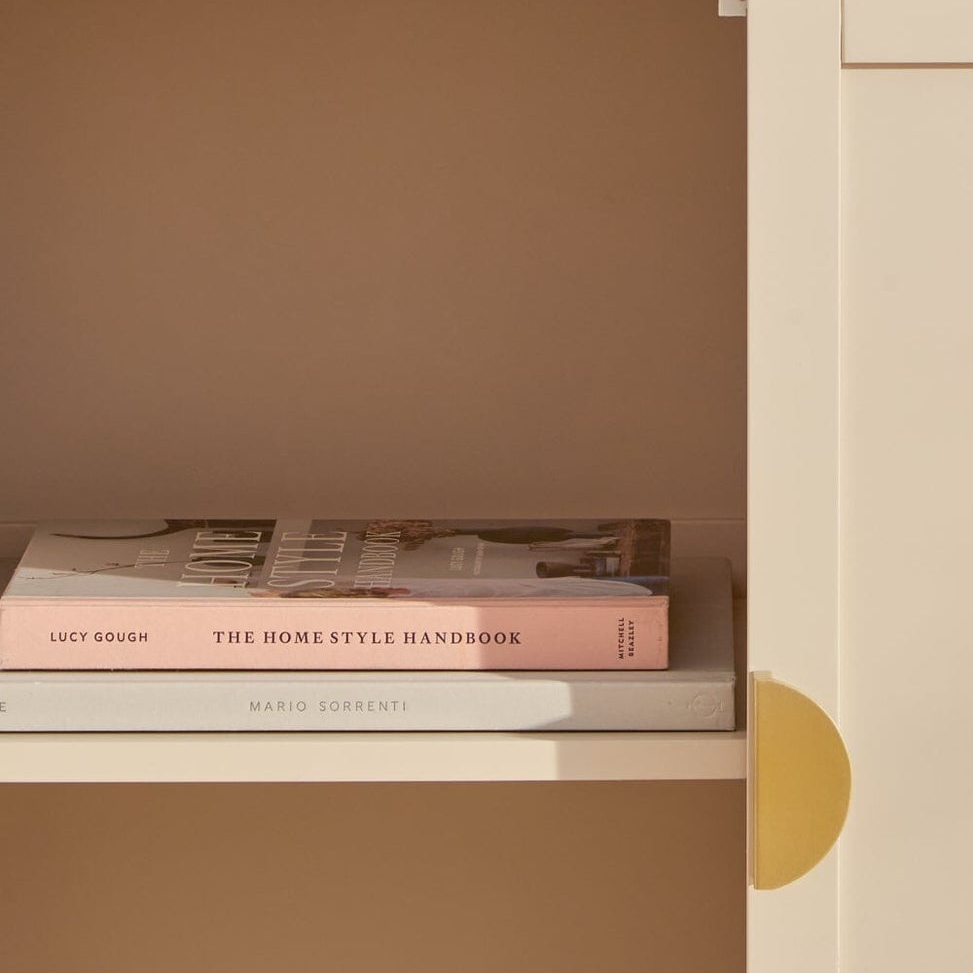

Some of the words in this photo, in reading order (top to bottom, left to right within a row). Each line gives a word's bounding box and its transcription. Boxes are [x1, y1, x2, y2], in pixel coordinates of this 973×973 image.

[177, 531, 262, 588] HOME
[267, 531, 348, 589] STYLE
[354, 530, 401, 589] HANDBOOK
[50, 631, 88, 642] LUCY
[94, 631, 148, 642] GOUGH
[213, 631, 254, 644] THE
[263, 631, 324, 644] HOME
[330, 631, 395, 644] STYLE
[403, 631, 522, 645] HANDBOOK
[249, 700, 307, 712] MARIO
[319, 700, 406, 712] SORRENTI
